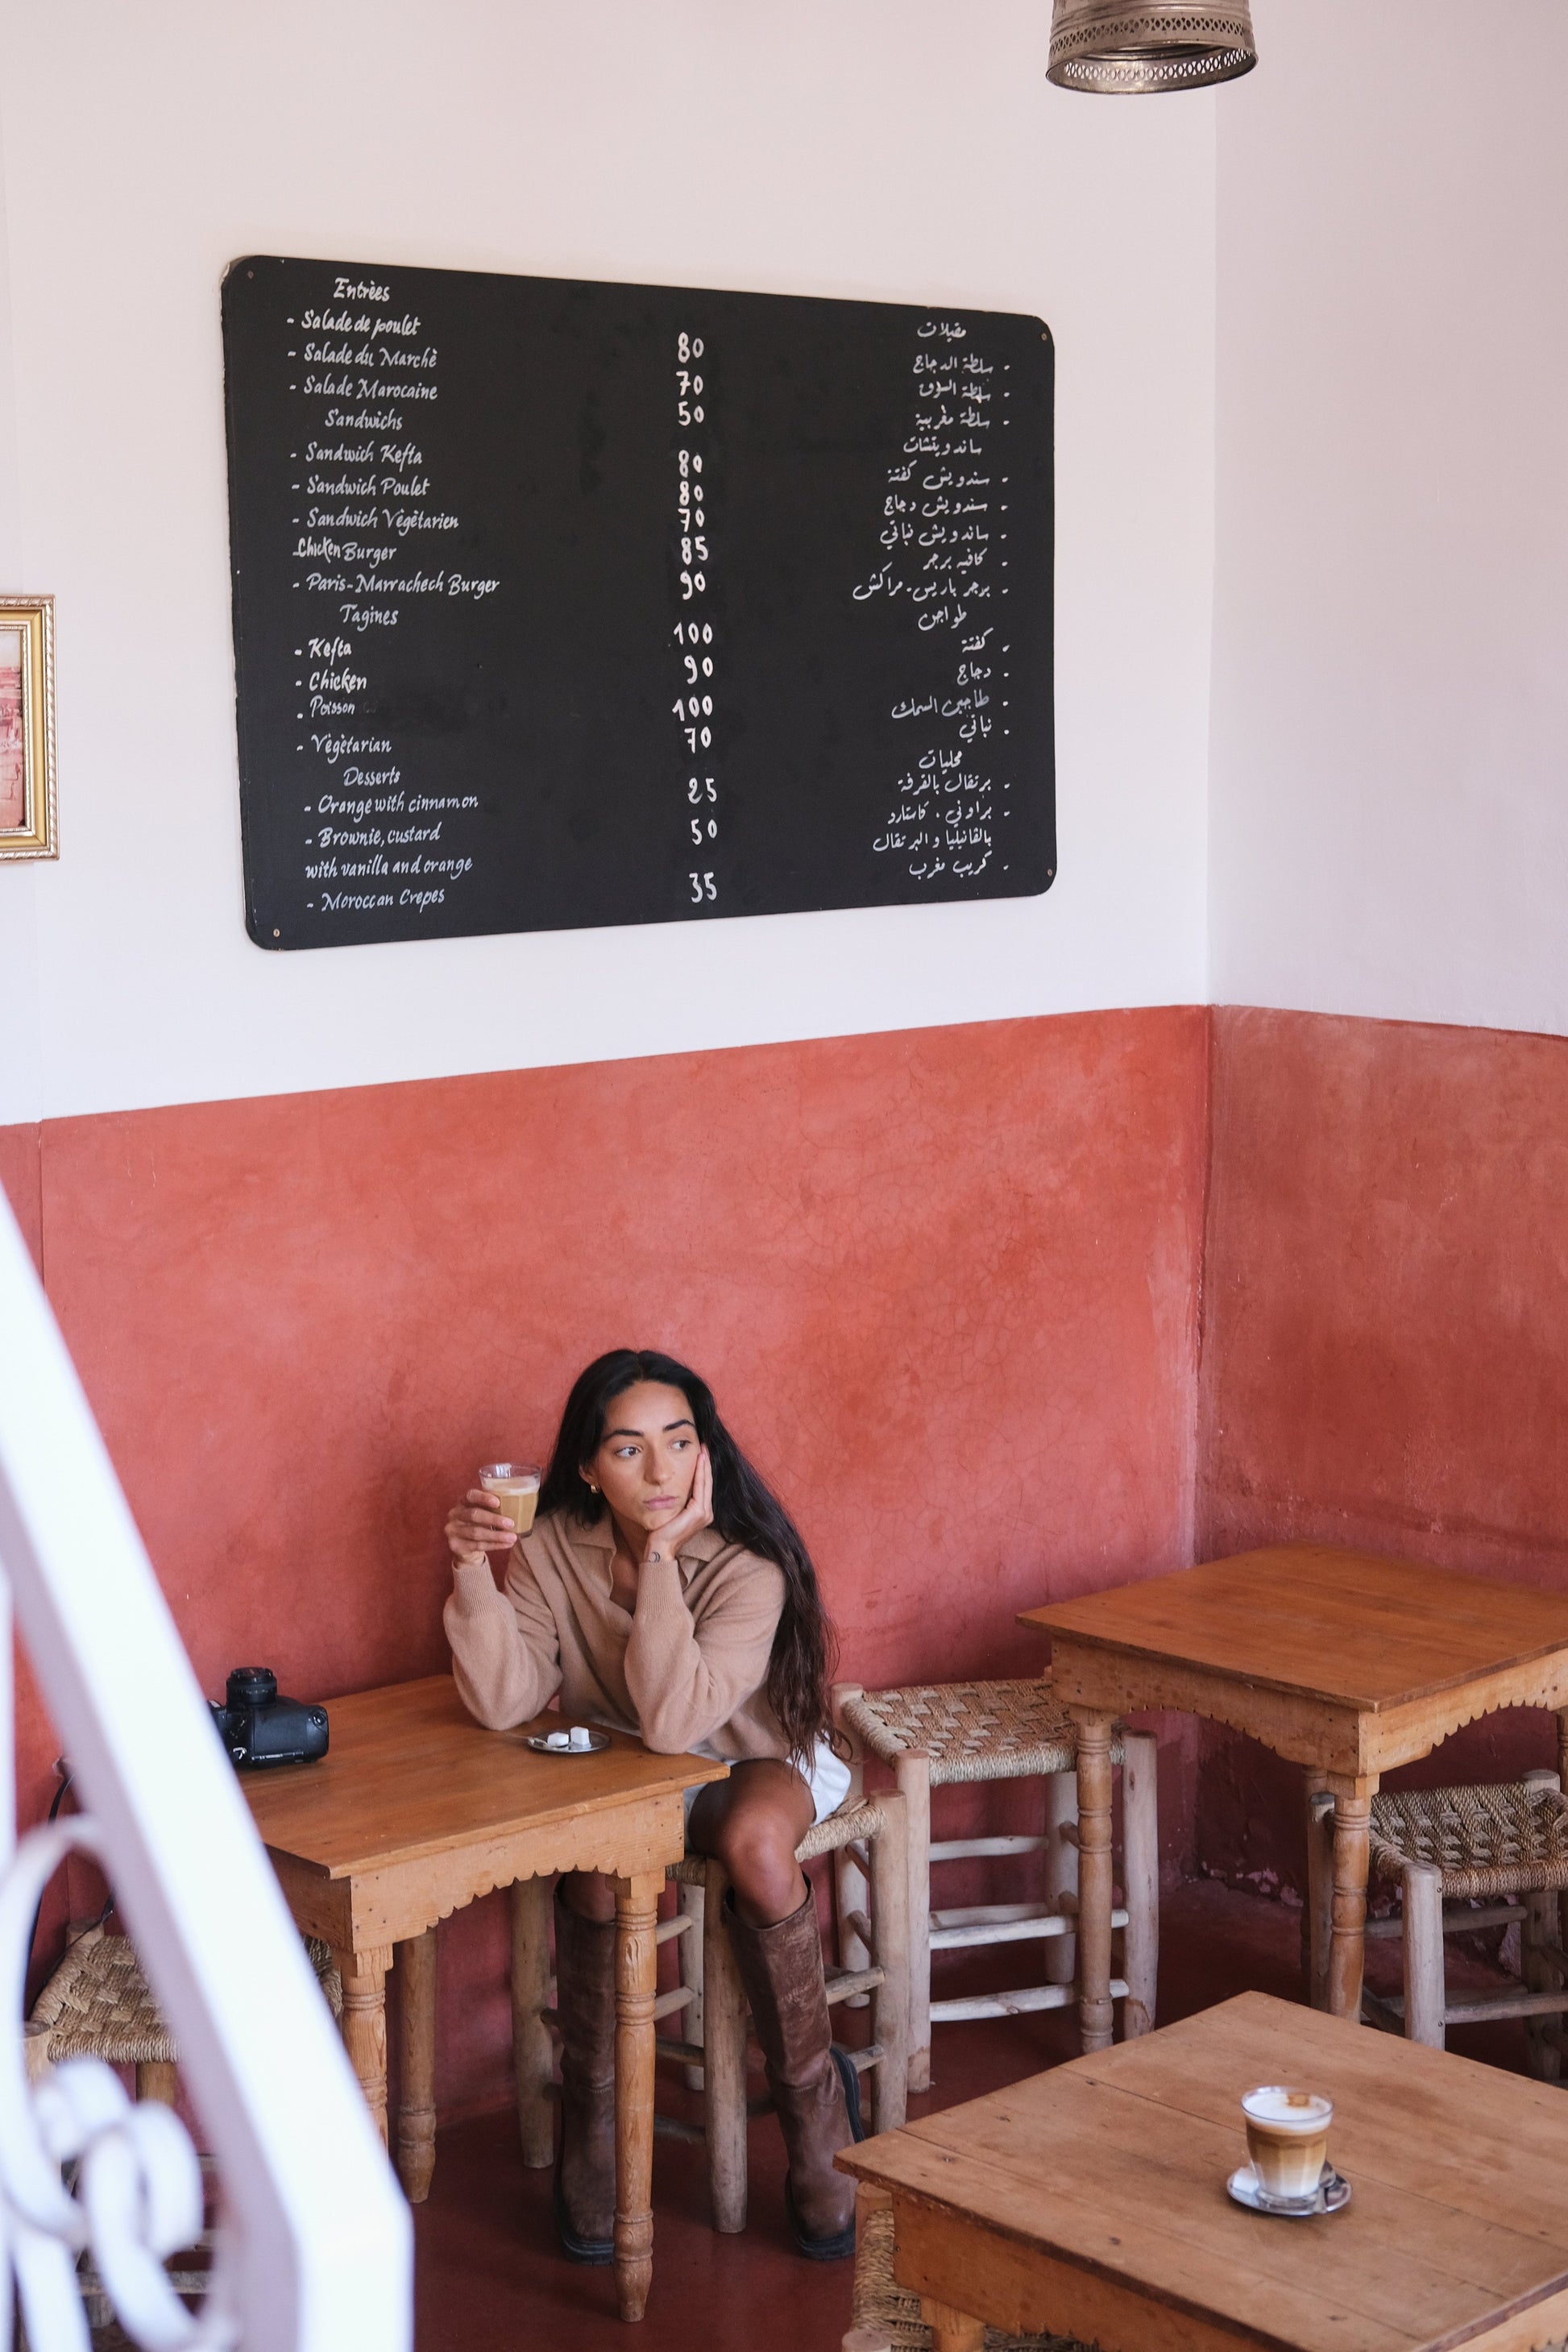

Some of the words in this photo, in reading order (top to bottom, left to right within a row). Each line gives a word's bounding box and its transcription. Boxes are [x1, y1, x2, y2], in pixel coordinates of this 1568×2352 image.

[301, 308, 353, 333] Salade
[354, 314, 371, 333] de
[370, 313, 421, 340] poulet
[304, 341, 353, 365] Salade
[354, 343, 375, 367] du
[678, 331, 704, 363] 80
[912, 354, 958, 374] الدجاج
[962, 353, 993, 374] سلطة
[303, 372, 353, 397] Salade
[355, 378, 438, 400] Marocaine
[675, 370, 703, 396] 70
[961, 382, 991, 404] سلطة
[324, 408, 403, 431] Sandwichs
[678, 400, 705, 426] 50
[959, 406, 990, 429] سلطة
[305, 440, 375, 463] Sandwich
[380, 442, 423, 473] Kefta
[678, 449, 703, 479] 80
[306, 474, 376, 496] Sandwich
[380, 475, 431, 496] Poulet
[678, 480, 704, 507] 80
[306, 506, 379, 529] Sandwich
[883, 494, 917, 516] دجاج
[677, 507, 705, 533] 70
[880, 520, 914, 550] نباتي
[296, 536, 341, 564] Chicken
[341, 541, 397, 569] Burger
[680, 535, 709, 566] 85
[923, 553, 952, 570] برجر
[305, 570, 445, 594] Paris-Marrachech
[447, 574, 500, 600] Burger
[679, 570, 706, 600] 90
[339, 604, 399, 633] Tagines
[673, 622, 713, 645] 100
[961, 627, 994, 653] كفتة
[308, 636, 352, 666] Kefta
[309, 666, 367, 695] Chicken
[683, 654, 714, 685] 90
[956, 662, 992, 686] دجاج
[309, 695, 355, 718] Poisson
[671, 695, 713, 722] 100
[683, 726, 711, 754] 70
[959, 714, 992, 744] نباتي
[342, 765, 401, 786] Desserts
[944, 773, 992, 793] برتقال
[687, 777, 717, 804] 25
[317, 794, 372, 823] Orange
[374, 790, 405, 813] with
[408, 794, 479, 813] cinnamon
[387, 821, 442, 844] custard
[691, 818, 718, 845] 50
[305, 856, 338, 879] with
[340, 853, 389, 877] vanilla
[392, 854, 422, 874] and
[423, 857, 473, 881] orange
[952, 849, 993, 878] كريب
[688, 871, 717, 903] 35
[321, 891, 394, 912] Moroccan
[399, 888, 445, 914] Crepes
